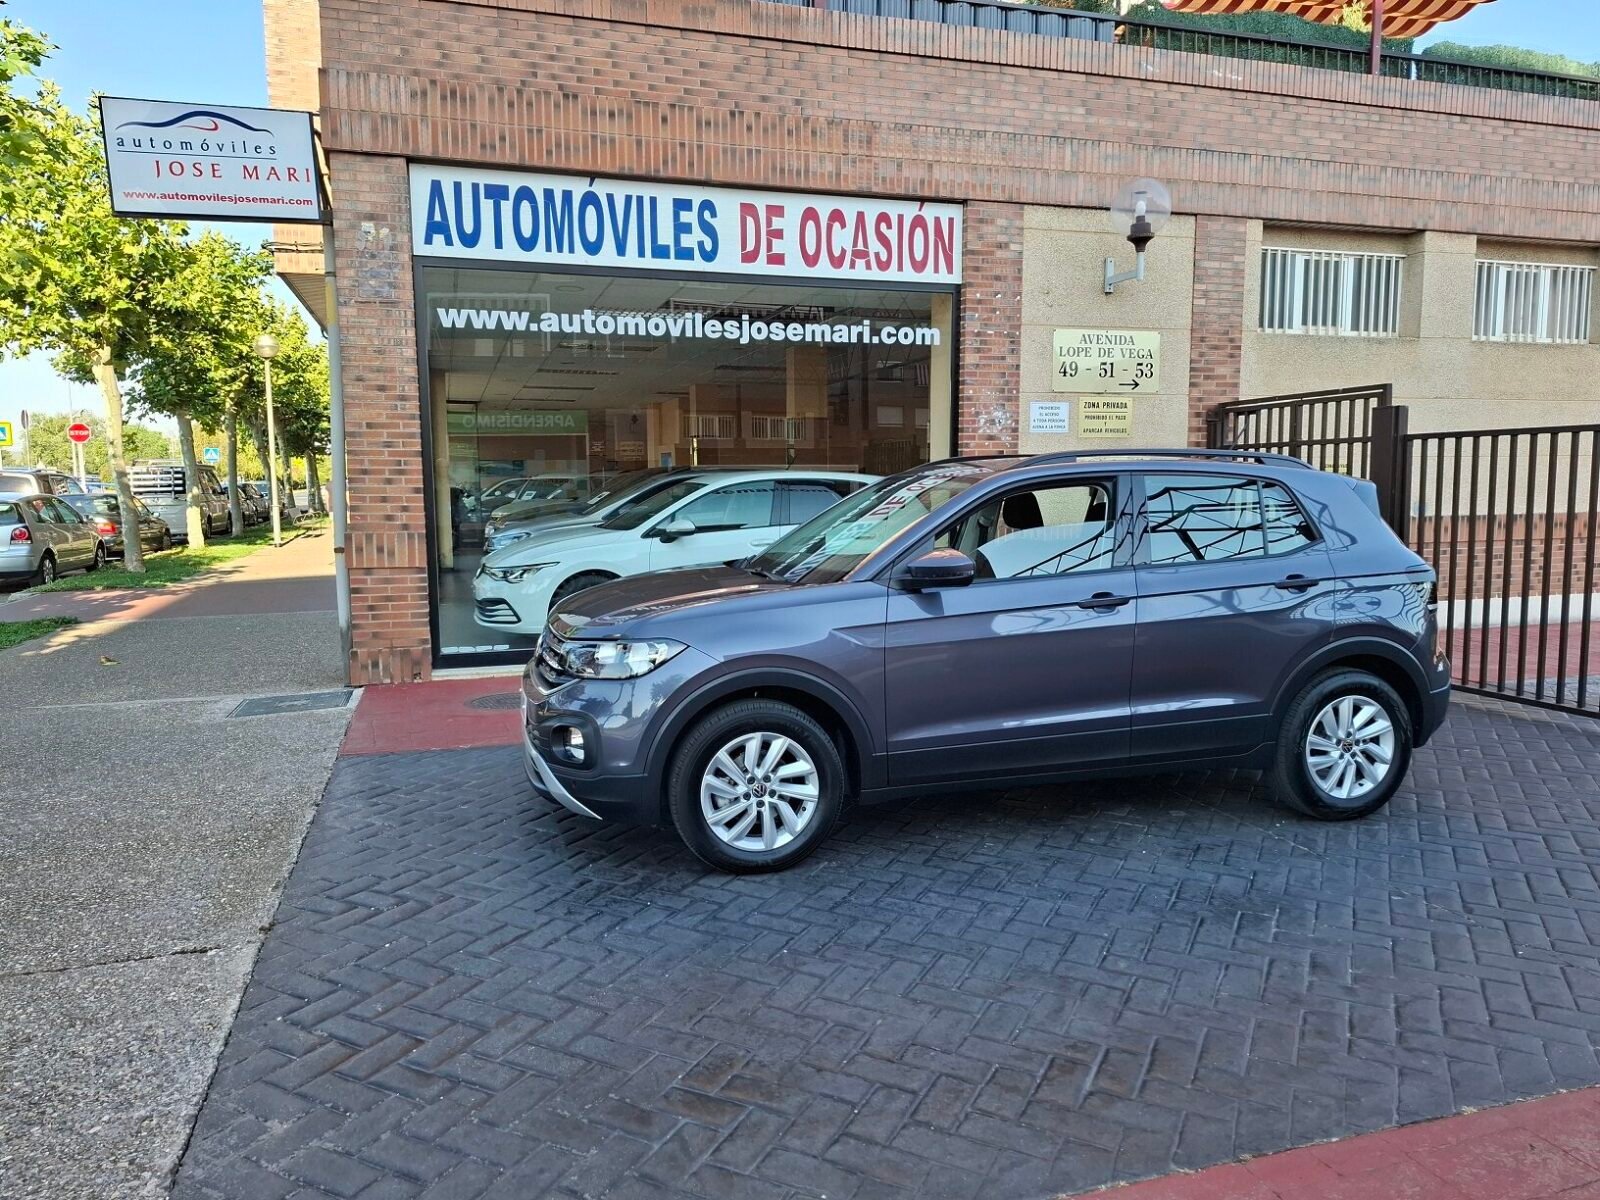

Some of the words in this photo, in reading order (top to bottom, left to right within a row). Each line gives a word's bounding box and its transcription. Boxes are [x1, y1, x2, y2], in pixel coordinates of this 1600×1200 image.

[116, 136, 277, 155] automóviles
[155, 160, 222, 179] JOSE
[243, 164, 312, 183] MARI
[123, 190, 313, 206] www.automovilesjosemari.com
[424, 177, 719, 263] AUTOMÓVILES
[739, 202, 786, 266] DE
[799, 201, 955, 275] OCASIÓN
[436, 305, 942, 347] www.automovilesjosemari.com
[1079, 334, 1135, 345] AVENIDA
[1059, 346, 1092, 358] LOPE
[1097, 348, 1115, 358] DE
[1119, 348, 1154, 360] VEGA
[1058, 361, 1079, 378] 49
[1098, 362, 1116, 378] 51
[1134, 362, 1155, 379] 53
[1083, 401, 1100, 409] ZONA
[1102, 402, 1128, 410] PRIVADA
